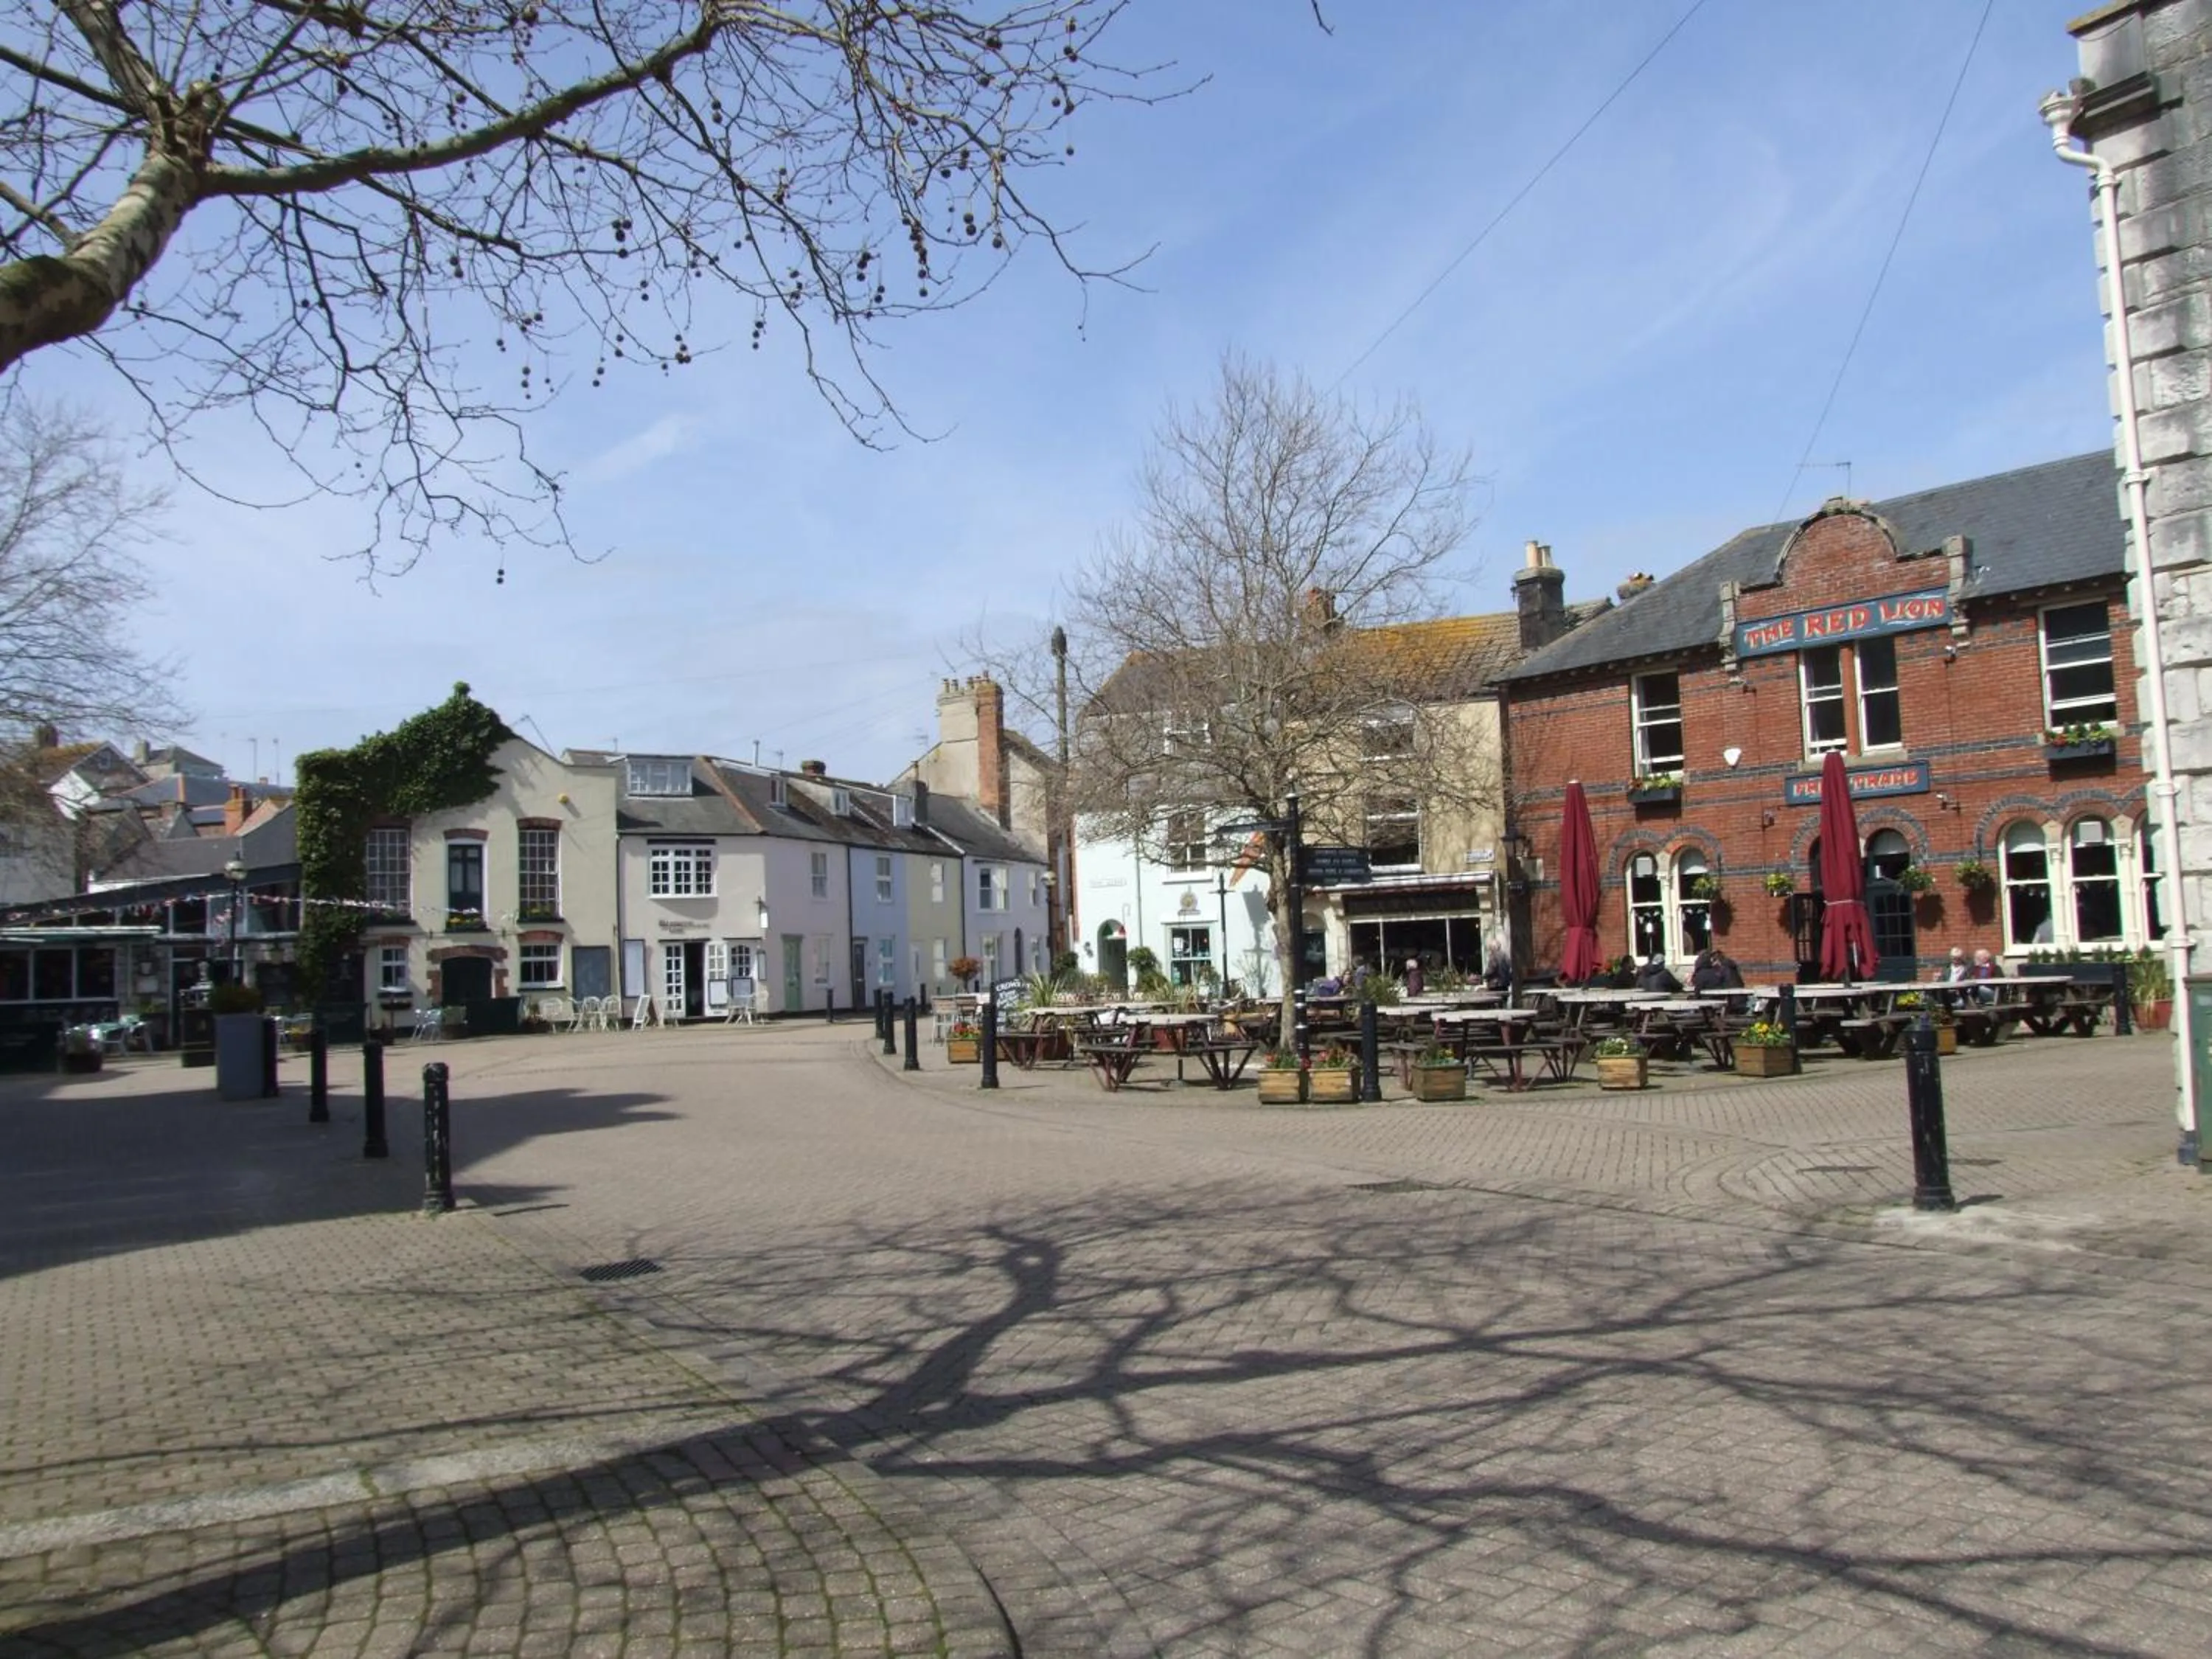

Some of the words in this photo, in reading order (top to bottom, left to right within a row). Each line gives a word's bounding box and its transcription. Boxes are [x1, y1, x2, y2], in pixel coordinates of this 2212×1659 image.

[1745, 619, 1794, 649] THE
[1804, 605, 1871, 637] RED
[1879, 598, 1946, 621] LION
[1793, 779, 1823, 797] FR
